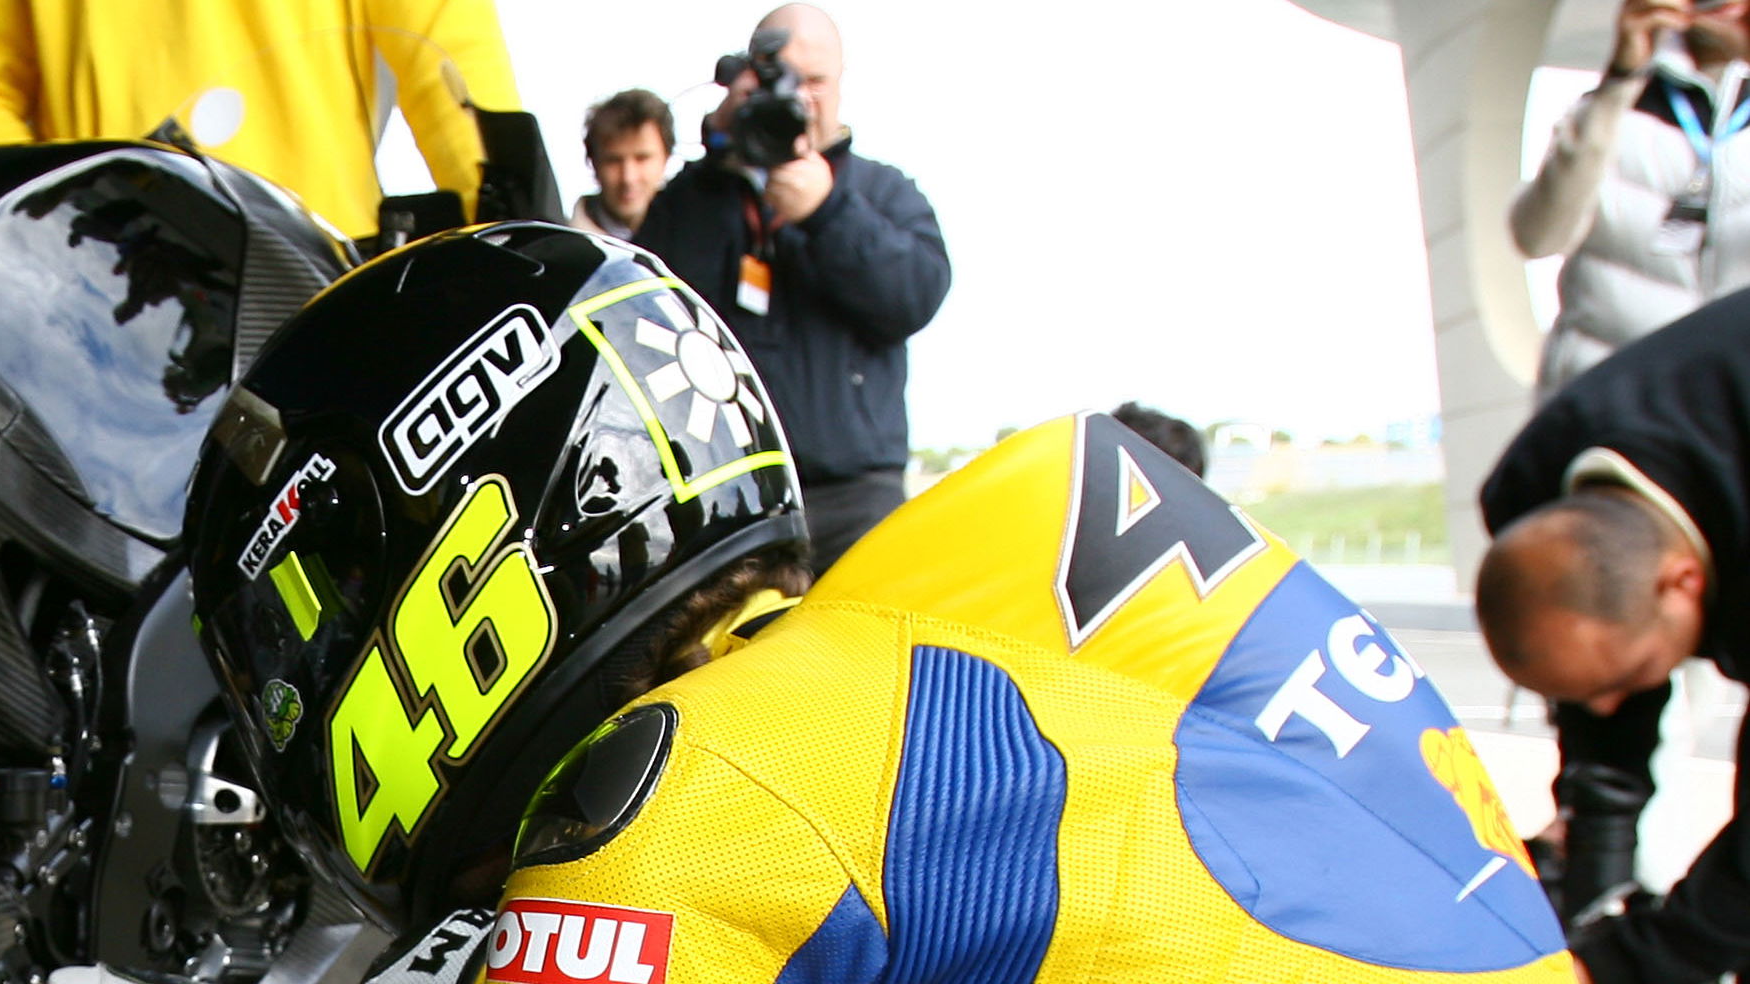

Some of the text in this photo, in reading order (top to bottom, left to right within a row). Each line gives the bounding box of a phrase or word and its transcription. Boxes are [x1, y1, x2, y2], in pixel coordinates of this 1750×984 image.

[406, 328, 526, 460] agv
[327, 477, 555, 877] 46
[1254, 609, 1425, 758] TE
